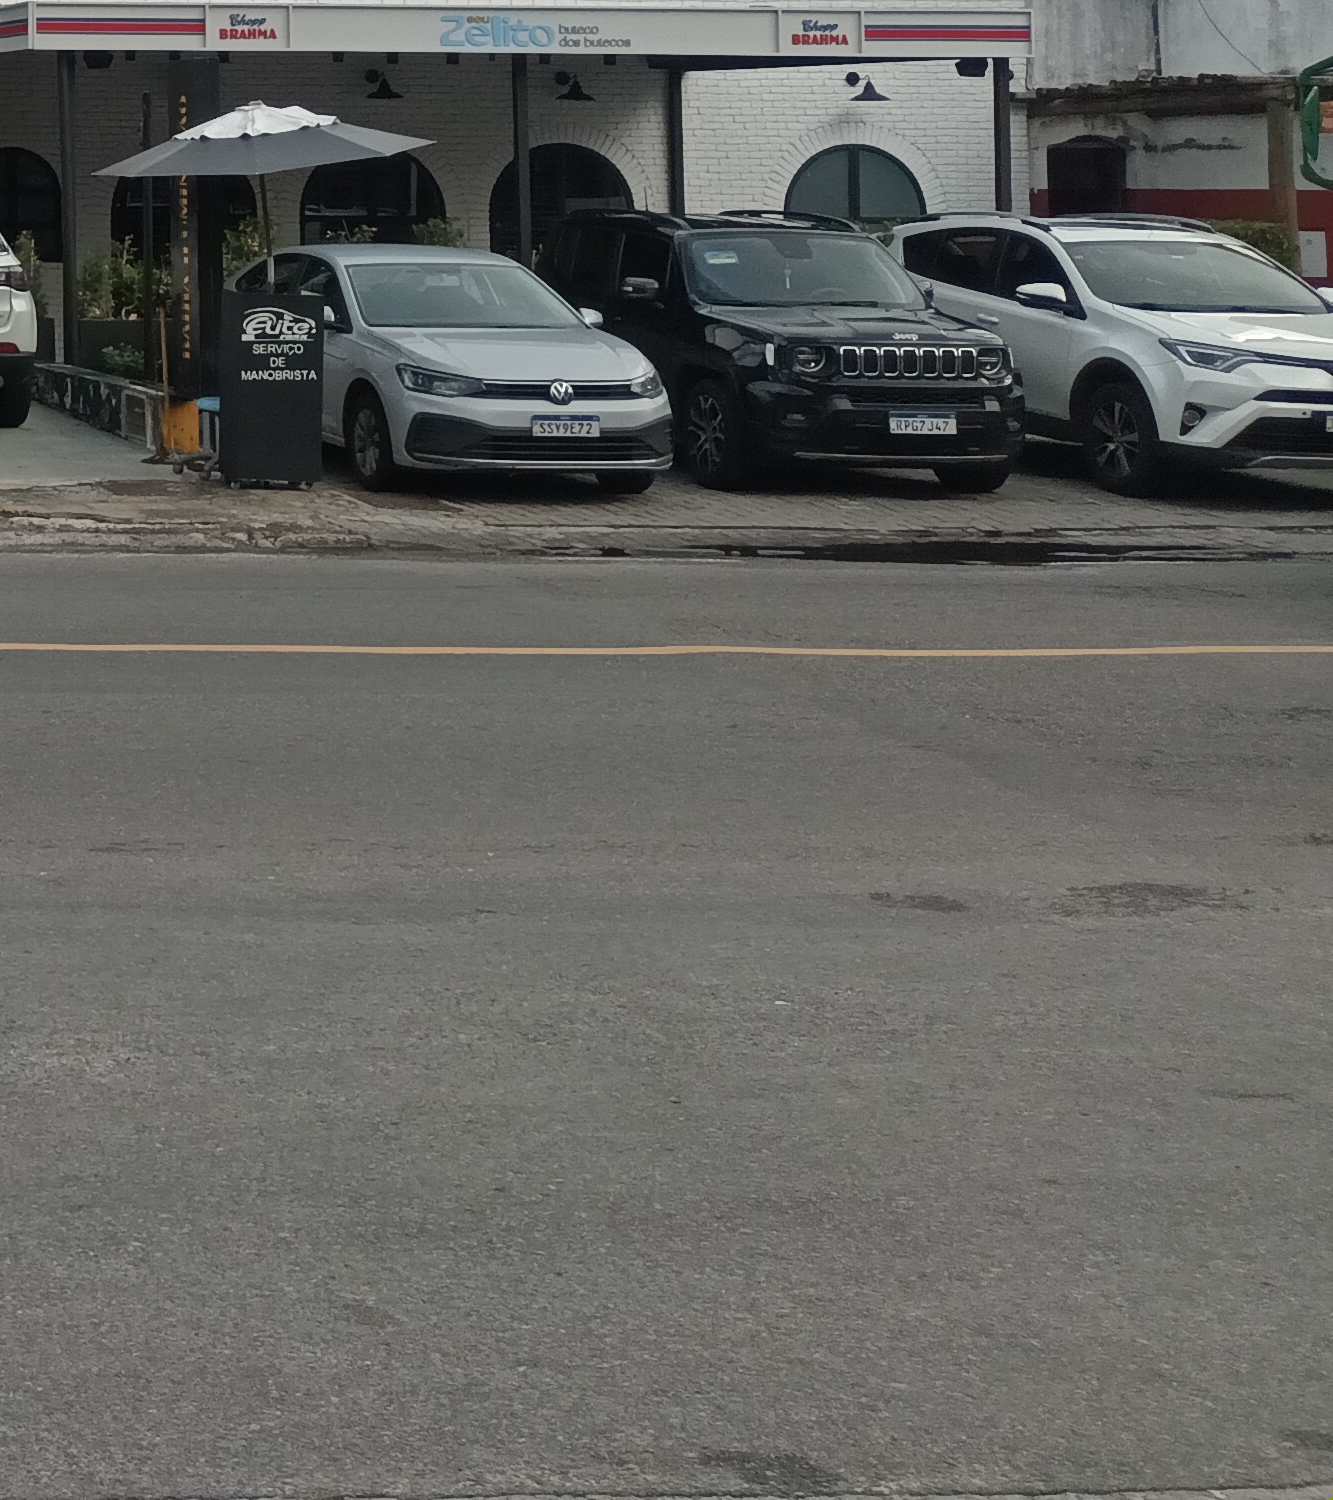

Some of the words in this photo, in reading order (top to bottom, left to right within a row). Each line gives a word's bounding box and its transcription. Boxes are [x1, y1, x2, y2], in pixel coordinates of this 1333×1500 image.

[229, 14, 266, 27] Chopp
[440, 15, 555, 47] Zelito
[558, 24, 599, 35] buteco
[802, 20, 838, 33] Chopp
[219, 28, 277, 39] BRAHMA
[558, 36, 581, 48] dos
[584, 36, 631, 48] butecos
[792, 34, 849, 45] BRAHMA
[252, 344, 304, 355] SERVIÇO
[270, 357, 286, 367] DE
[241, 370, 317, 380] MANOBRISTA
[539, 422, 593, 435] SSY9E72
[896, 420, 949, 433] RPG7J47
